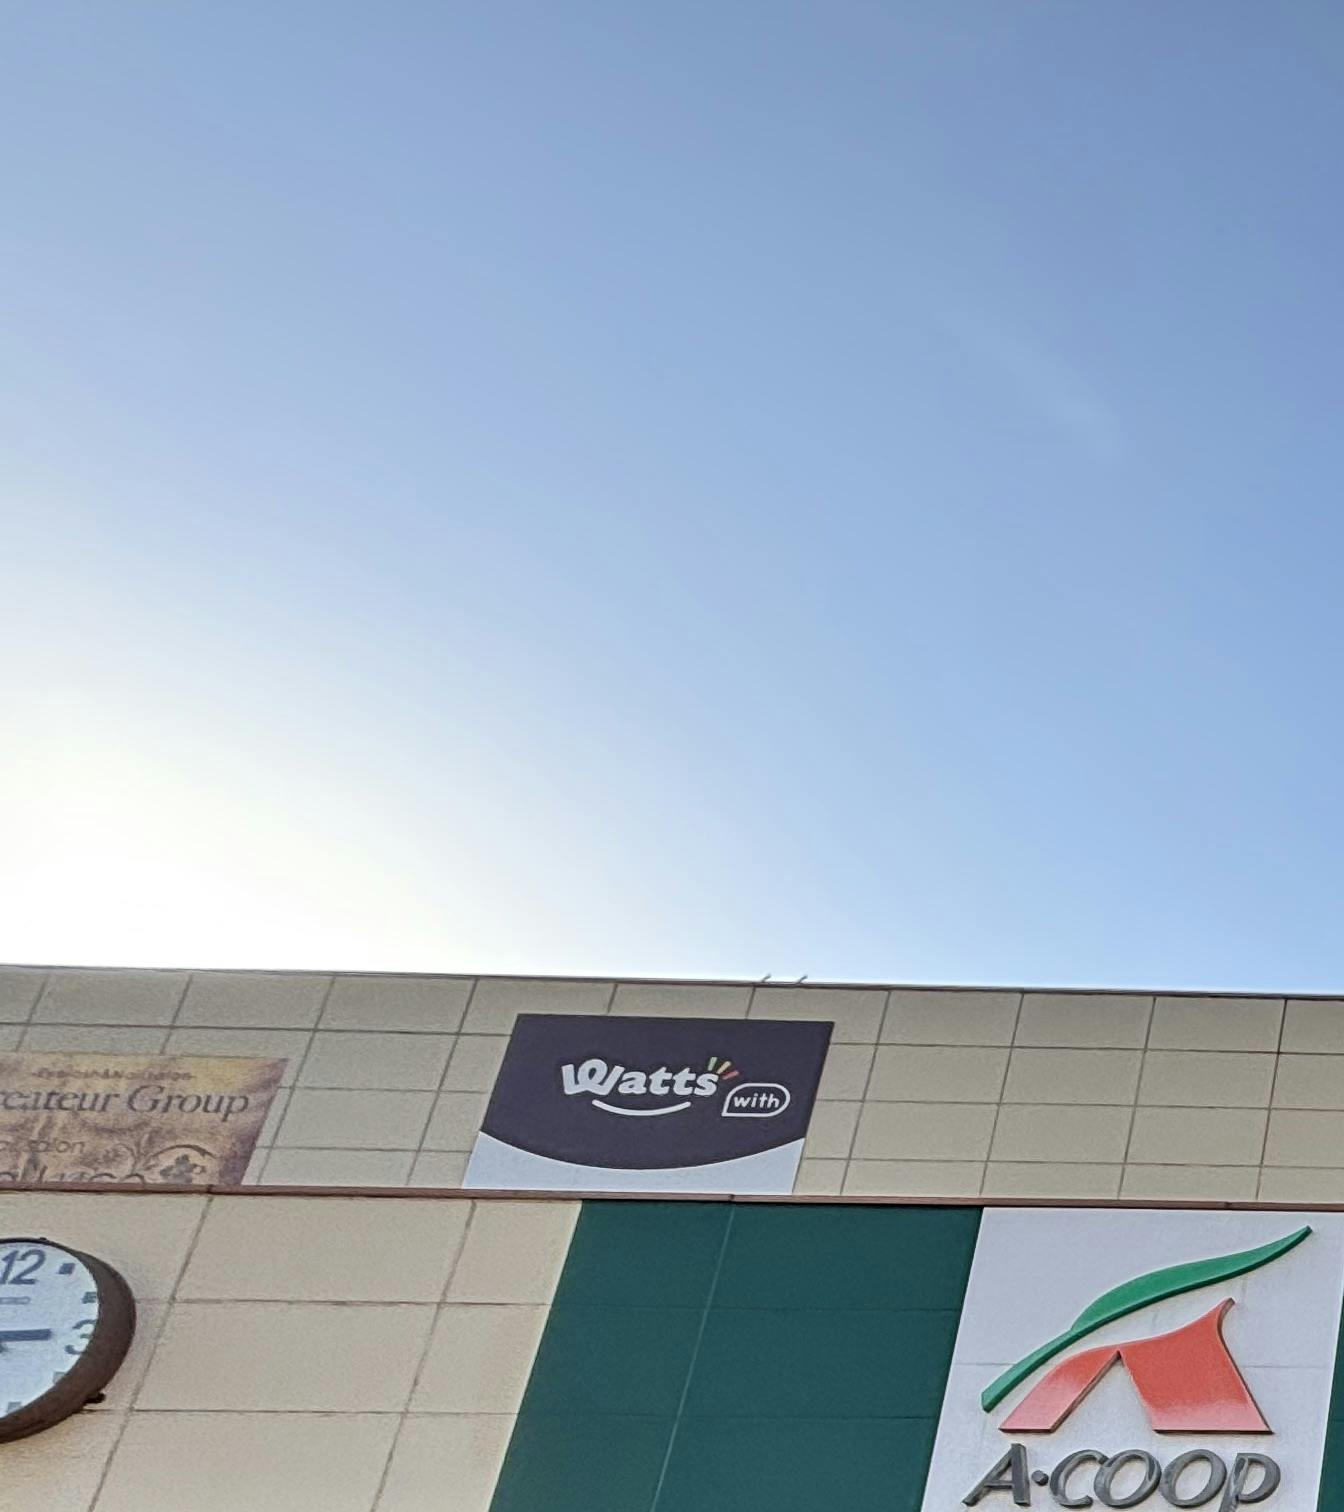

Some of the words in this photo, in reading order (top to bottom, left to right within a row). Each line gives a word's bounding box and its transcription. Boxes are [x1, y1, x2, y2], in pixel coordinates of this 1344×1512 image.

[561, 1058, 720, 1097] Watts
[127, 1084, 249, 1122] Group
[734, 1093, 780, 1108] with
